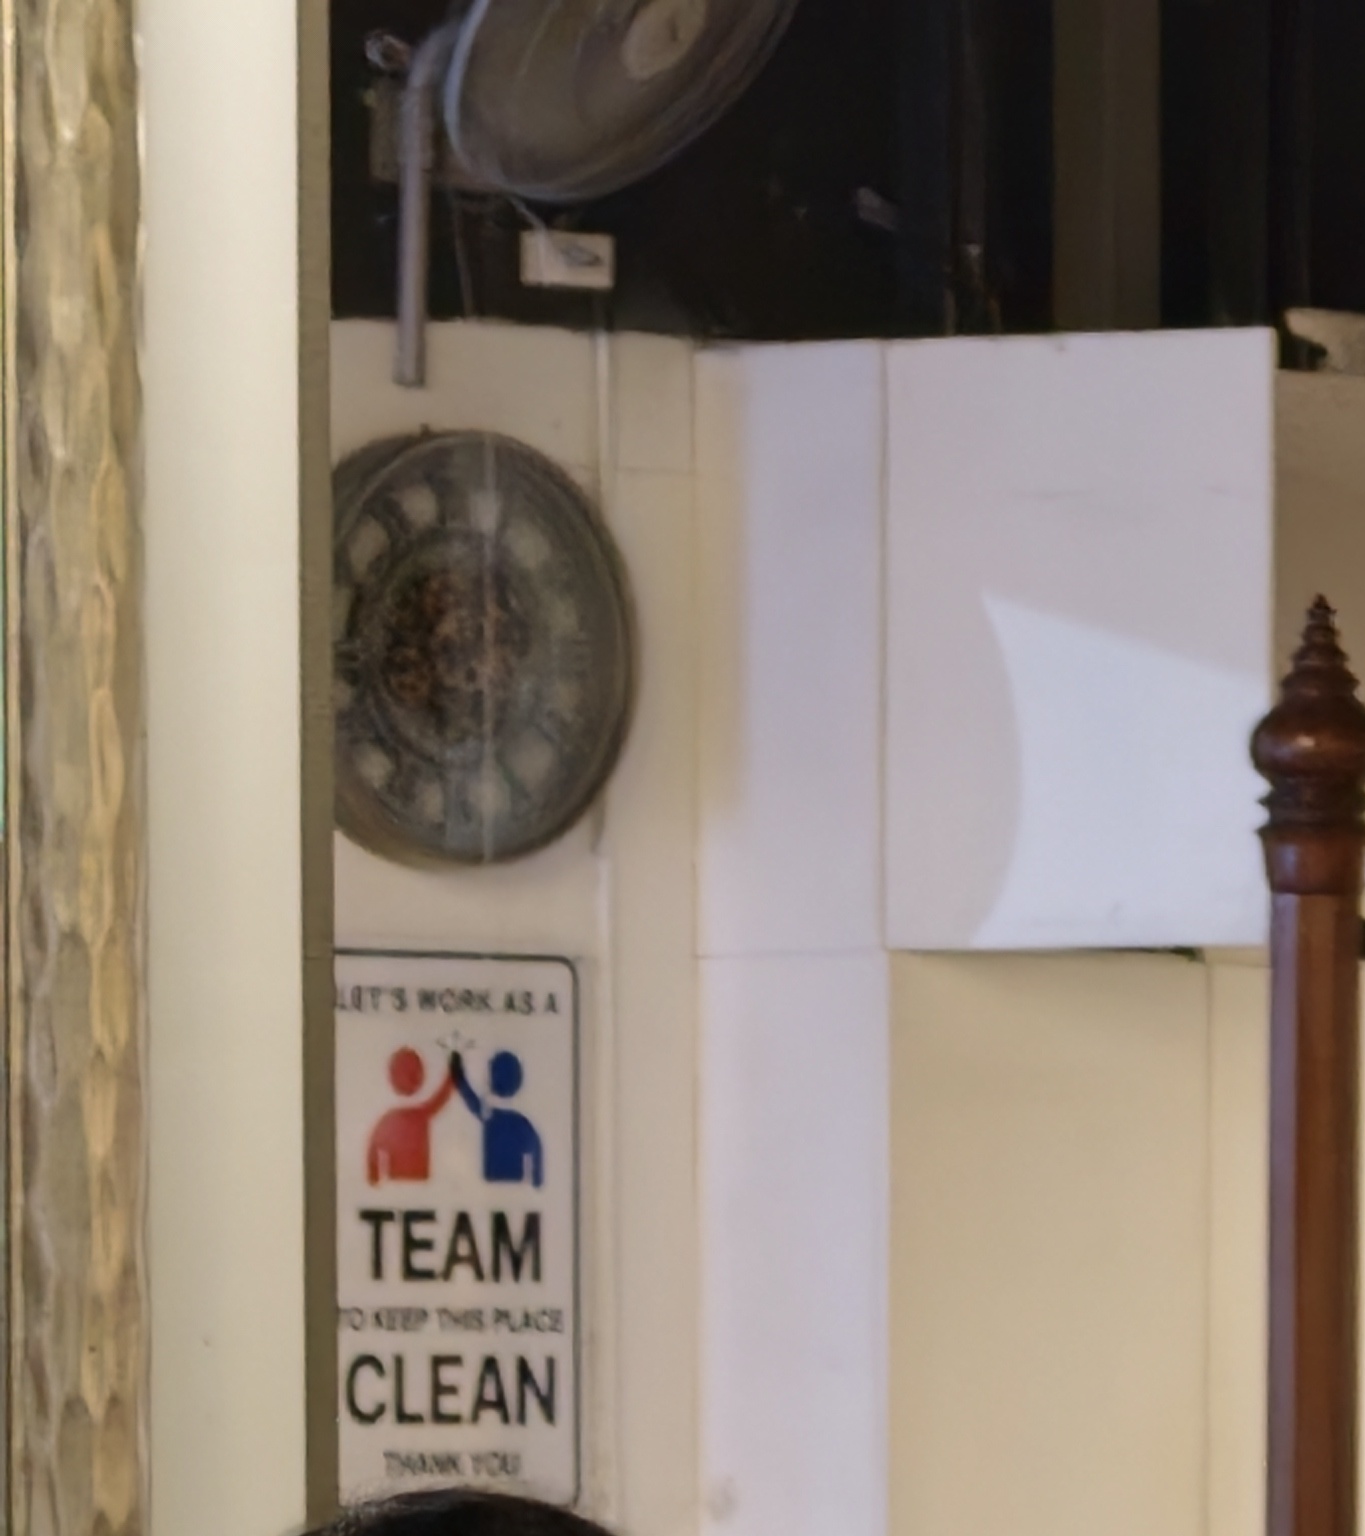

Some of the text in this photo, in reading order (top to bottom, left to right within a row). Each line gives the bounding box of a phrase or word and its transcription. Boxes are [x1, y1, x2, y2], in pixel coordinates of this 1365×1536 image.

[417, 987, 492, 1014] WORK
[504, 990, 534, 1015] AS
[545, 992, 559, 1015] A
[359, 1210, 543, 1283] TEAM
[374, 1307, 428, 1332] KEEP
[437, 1308, 484, 1333] THIS
[494, 1308, 563, 1333] PLACE
[345, 1354, 557, 1426] CLEAN
[383, 1452, 463, 1477] THANK
